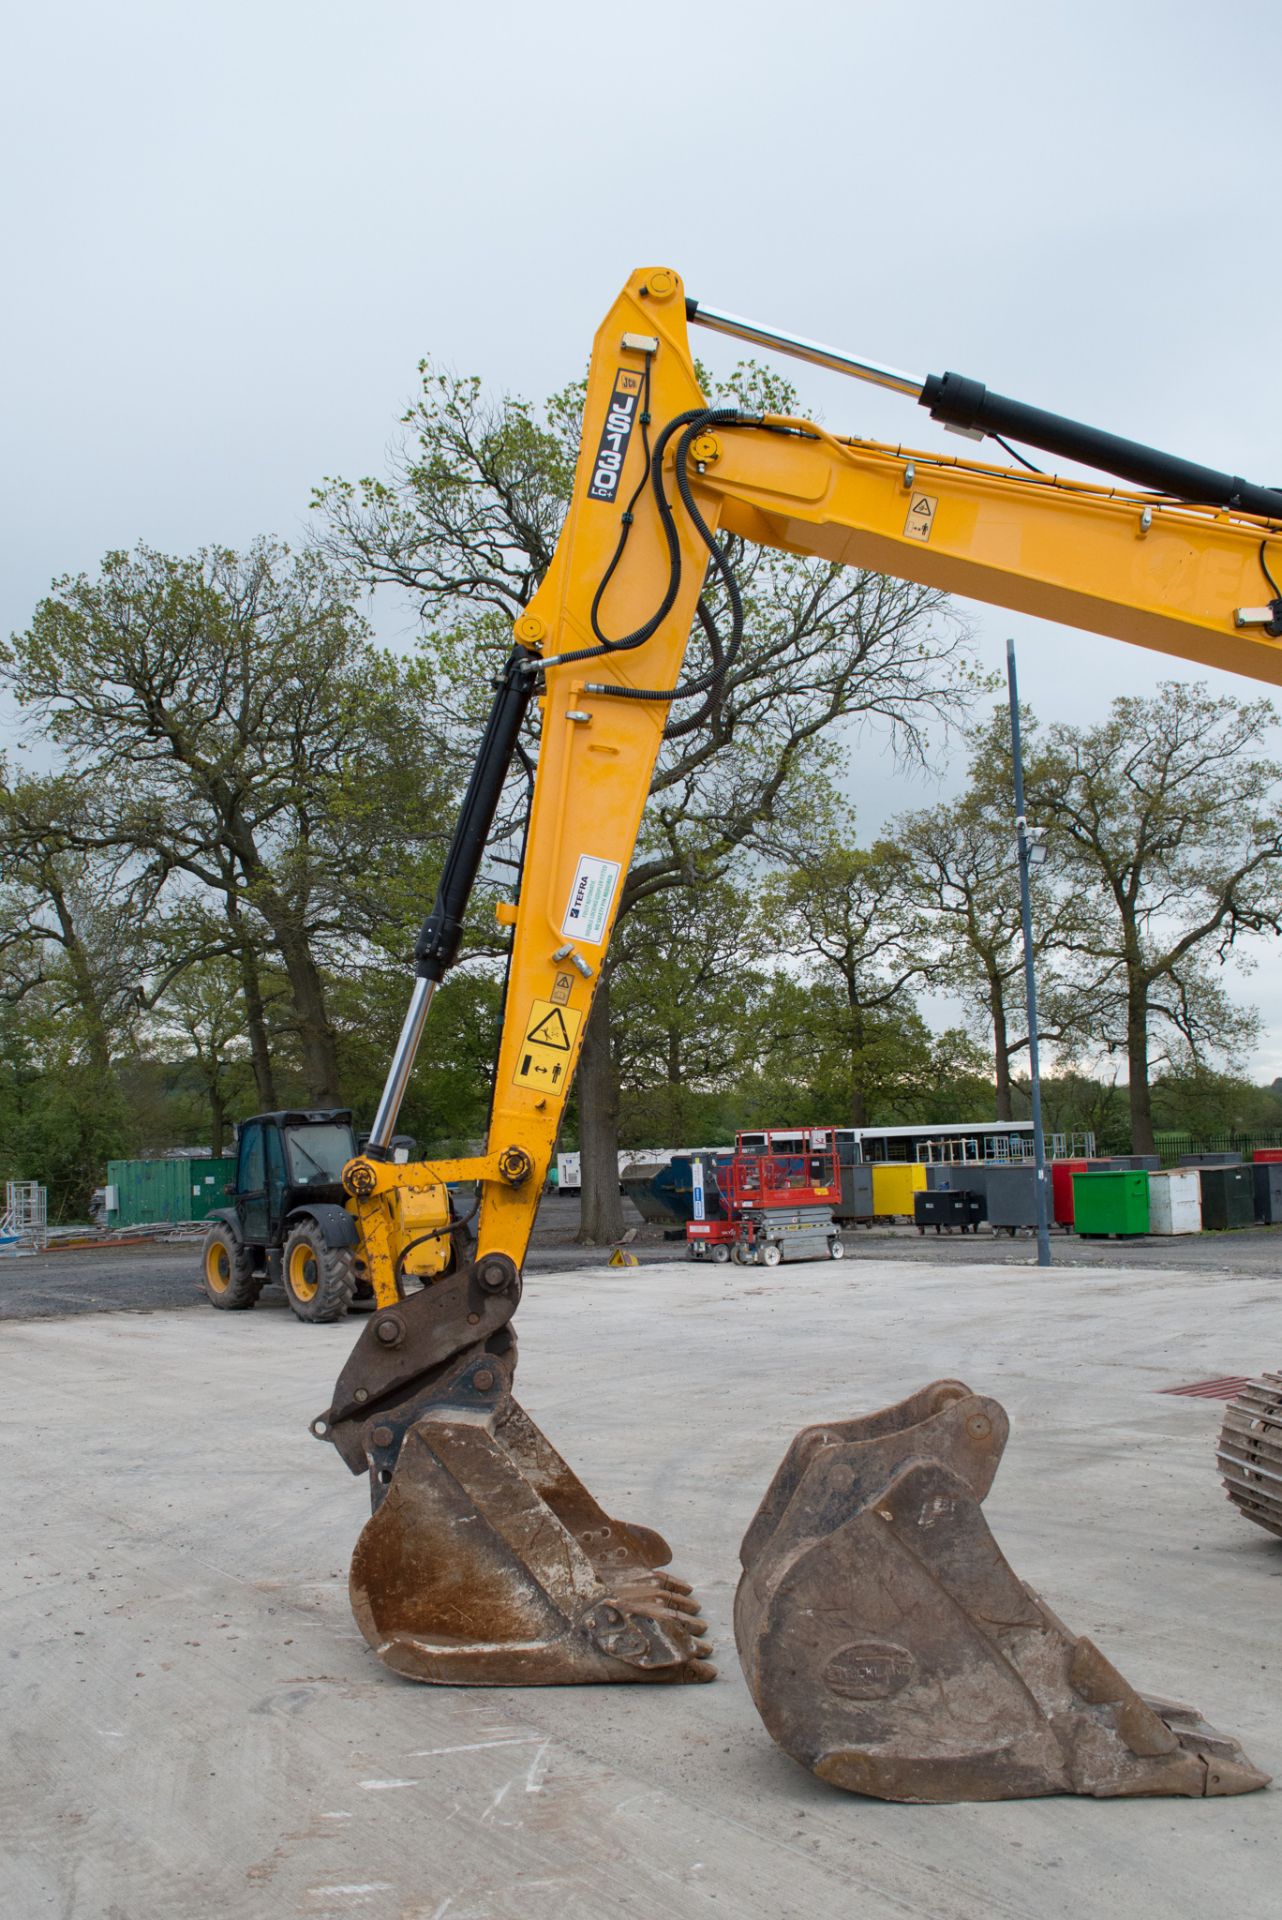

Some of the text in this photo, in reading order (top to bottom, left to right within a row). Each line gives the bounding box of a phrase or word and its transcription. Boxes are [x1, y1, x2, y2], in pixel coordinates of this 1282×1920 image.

[593, 397, 634, 489] JS130
[591, 487, 613, 498] LC+
[575, 876, 589, 907] TEFRA
